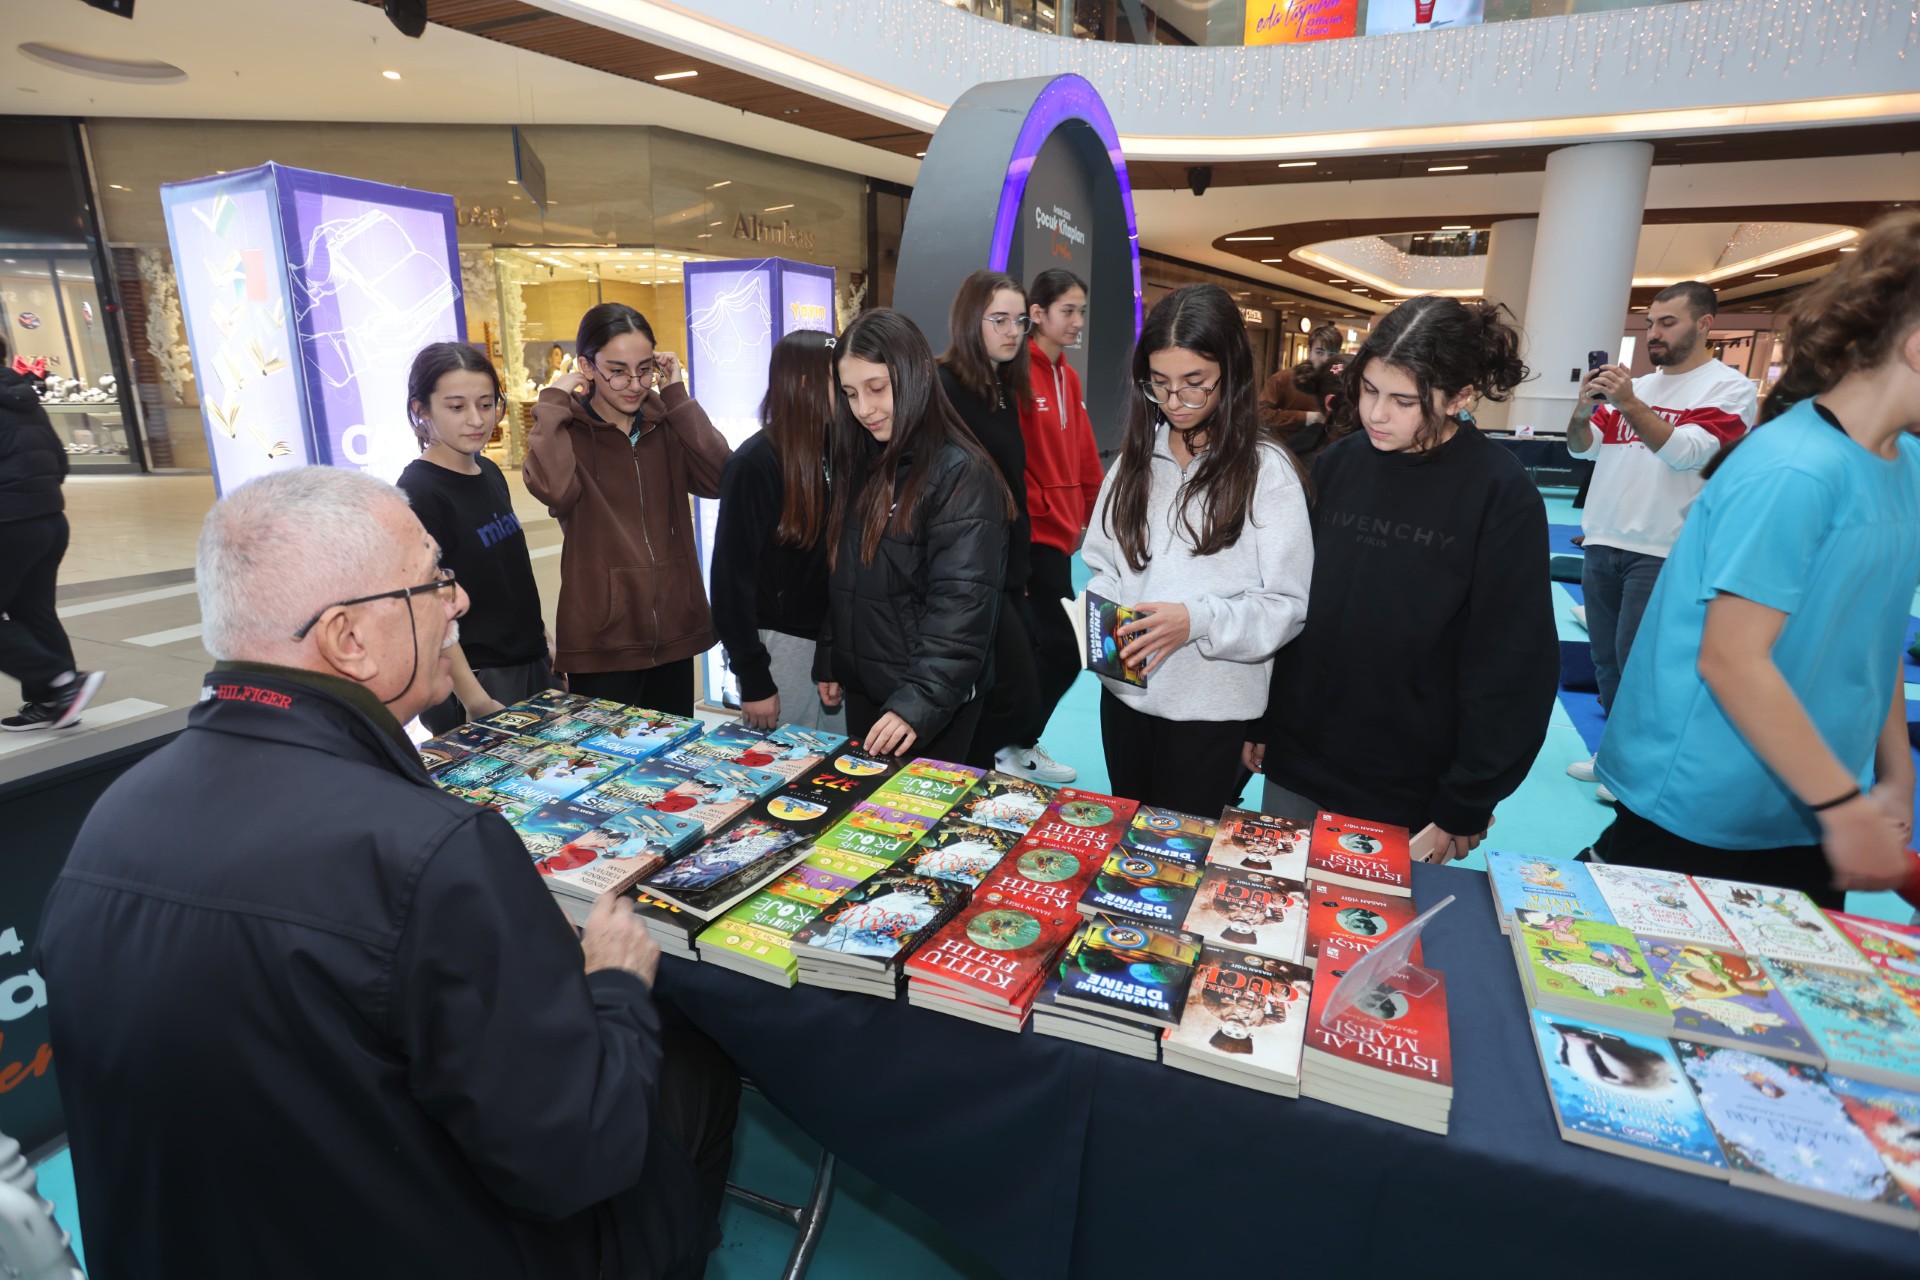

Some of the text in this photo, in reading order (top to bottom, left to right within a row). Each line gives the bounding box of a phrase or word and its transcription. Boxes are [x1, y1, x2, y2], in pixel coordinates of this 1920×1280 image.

[1303, 27, 1329, 36] Store
[1035, 206, 1058, 231] Çocuk
[1058, 218, 1085, 245] Kitapları
[1320, 509, 1456, 550] GIVENCHY
[1356, 534, 1388, 548] PARIS
[217, 685, 292, 710] HILFIGER
[811, 773, 860, 792] 372
[897, 775, 958, 797] PROJE
[835, 828, 902, 851] PROJE
[1032, 829, 1109, 851] KUTLU
[1043, 821, 1109, 842] FETİH
[1360, 825, 1384, 834] HASAN
[1315, 857, 1402, 884] İSTİKLAL
[1328, 853, 1389, 872] MARŞI
[996, 875, 1072, 900] FETİH
[1025, 905, 1052, 917] HASAN
[1360, 899, 1387, 908] HASAN
[938, 938, 1022, 974] FETİH
[919, 950, 1015, 990] KUTLU
[1248, 967, 1273, 977] HASAN
[1334, 1019, 1419, 1053] MARŞI
[1314, 1029, 1439, 1078] İSTİKLAL
